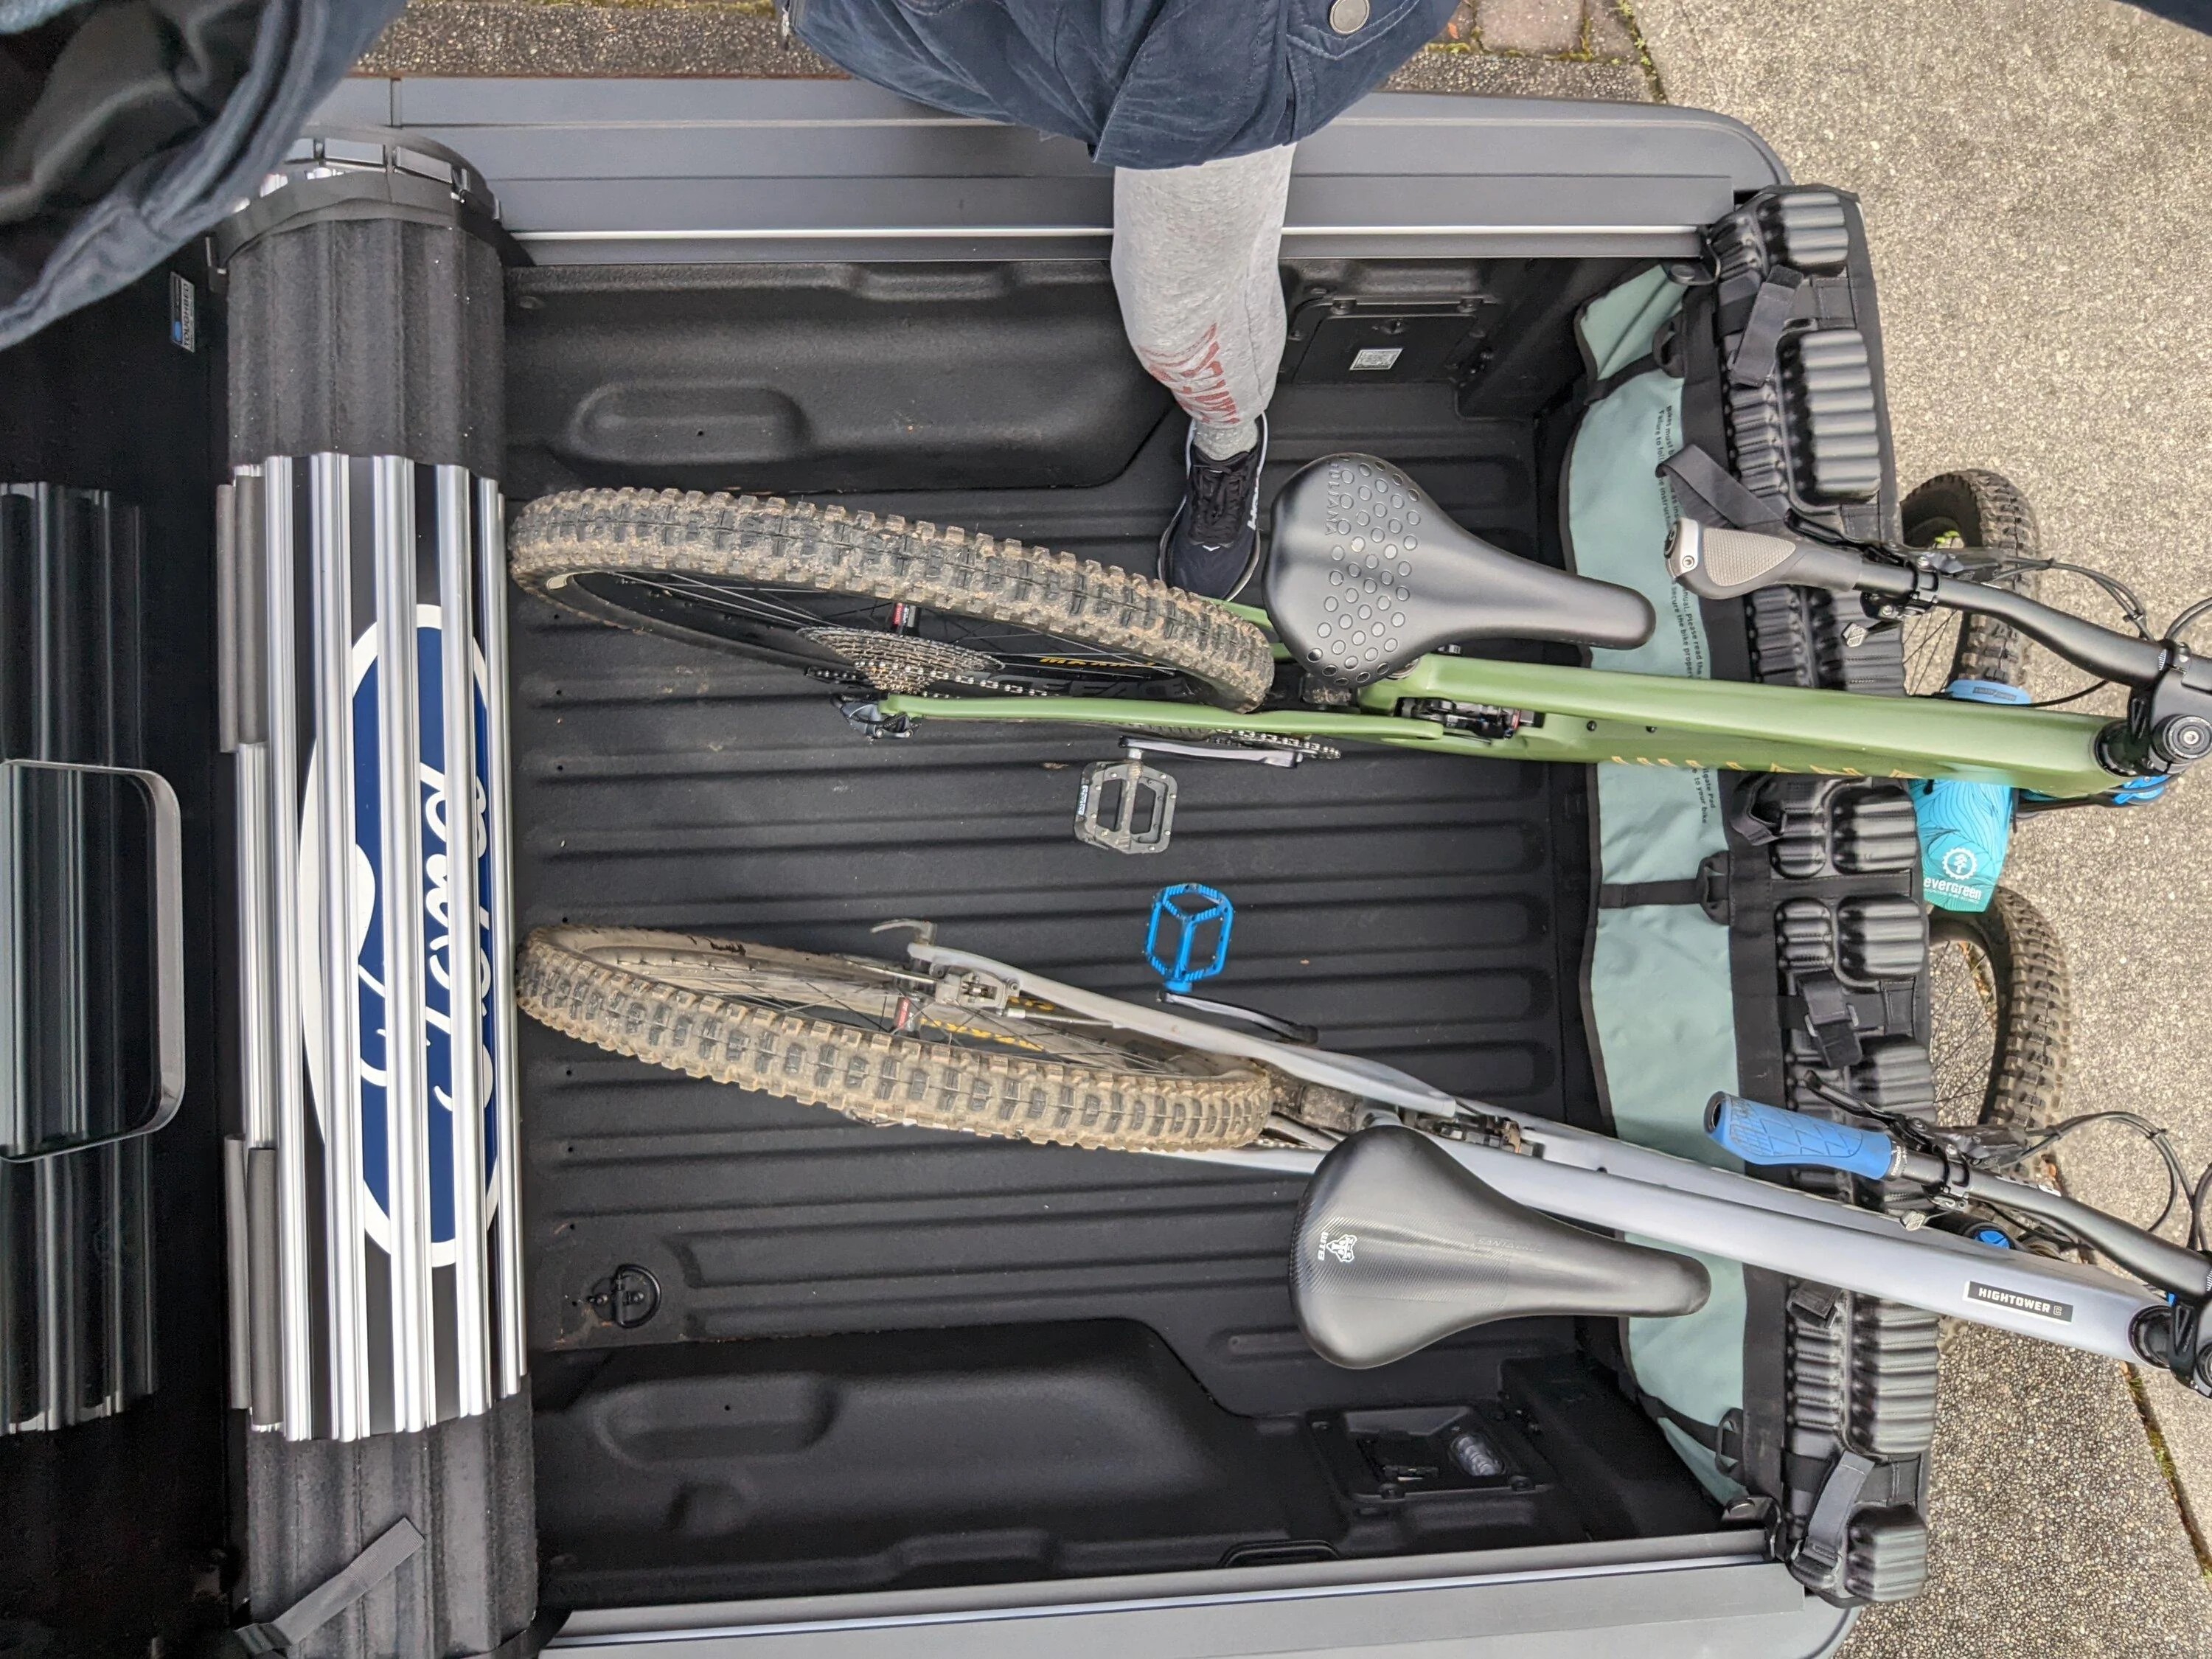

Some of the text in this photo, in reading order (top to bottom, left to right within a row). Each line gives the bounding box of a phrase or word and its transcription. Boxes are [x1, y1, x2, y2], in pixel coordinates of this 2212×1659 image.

[1655, 410, 1665, 435] Failure
[1656, 437, 1663, 446] to
[1665, 428, 1674, 448] must
[1671, 587, 1680, 613] secure
[1676, 614, 1685, 627] the
[1680, 629, 1689, 646] bike
[1686, 613, 1697, 639] Please
[1694, 641, 1703, 660] read
[1696, 787, 1706, 804] your
[1318, 1231, 1329, 1261] WTB
[1978, 1287, 2062, 1315] HIGHTOWER C
